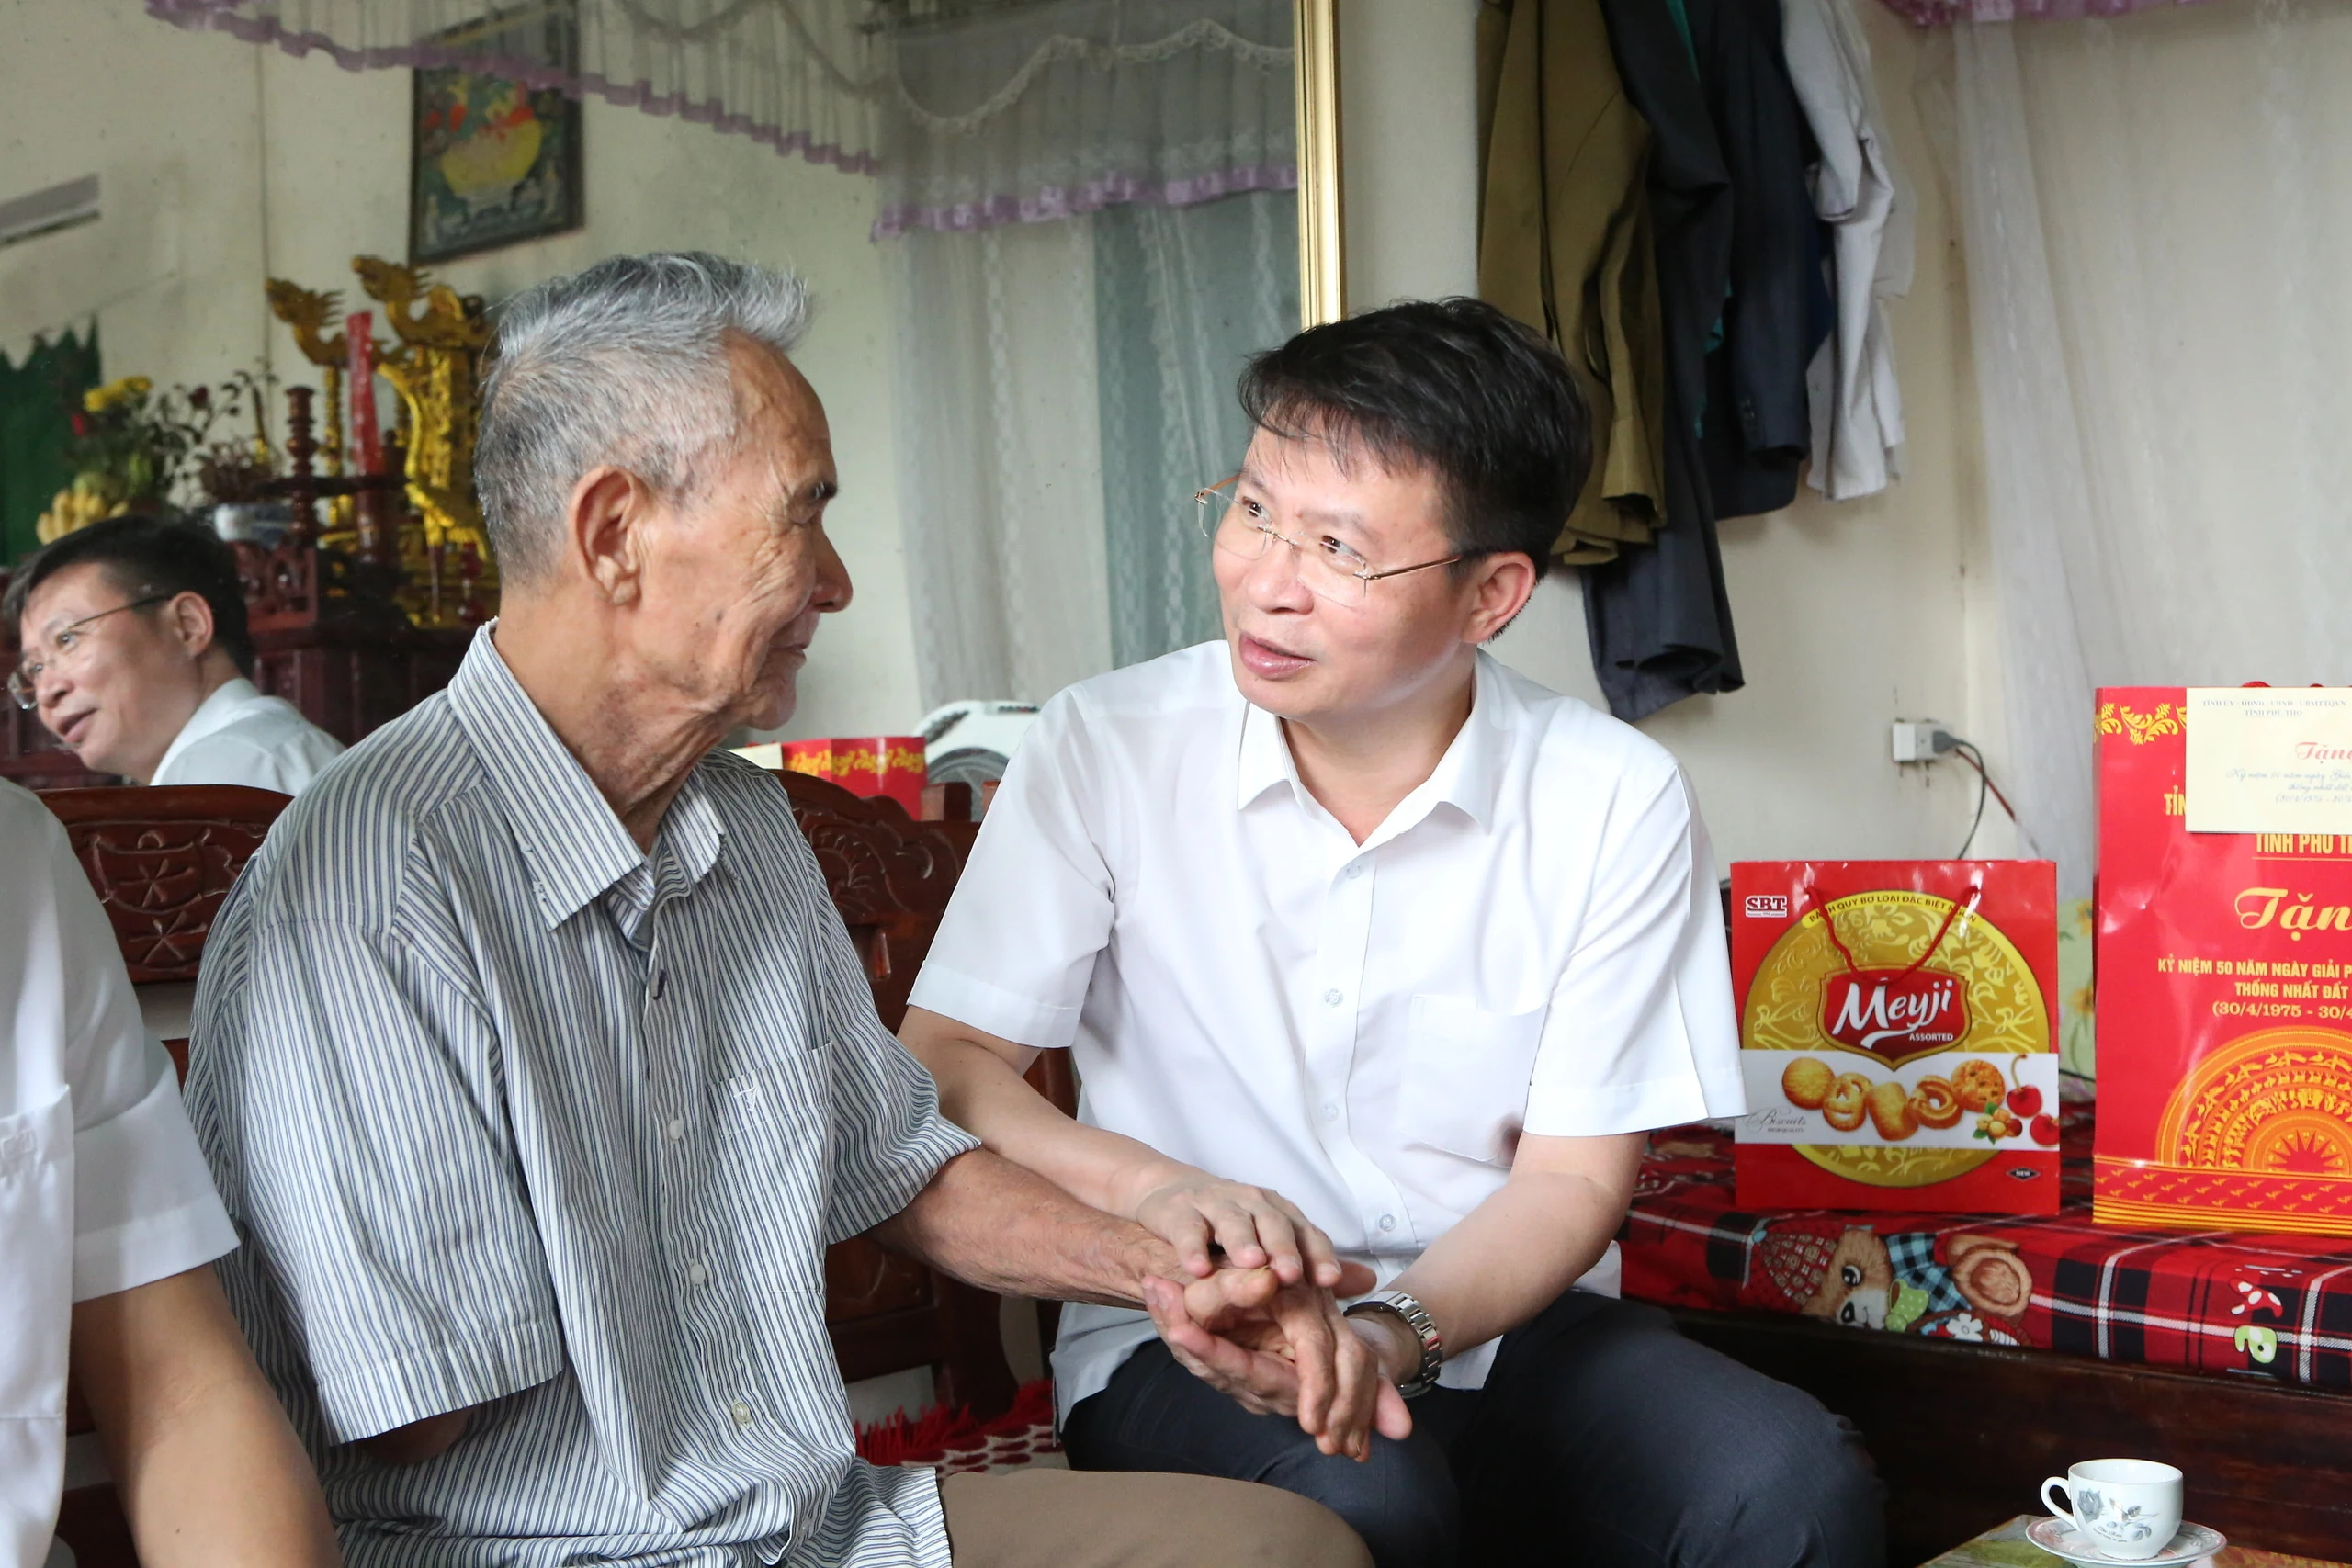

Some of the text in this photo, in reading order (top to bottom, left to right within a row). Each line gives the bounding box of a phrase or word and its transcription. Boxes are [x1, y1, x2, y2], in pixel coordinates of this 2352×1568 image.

[1838, 898, 1858, 909] QUY
[2157, 953, 2176, 973] KỶ
[2178, 957, 2212, 976] NIỆM
[2216, 960, 2233, 975] 50
[2236, 959, 2268, 976] NĂM
[2272, 961, 2309, 977] NGÀY
[2312, 958, 2340, 978] GIẢI
[2234, 977, 2349, 999] THỐNG NHẤT ĐẤT
[1831, 979, 1953, 1049] Meyji
[2212, 1000, 2301, 1018] (30/4/1975
[1909, 1033, 1953, 1042] ASSORTED
